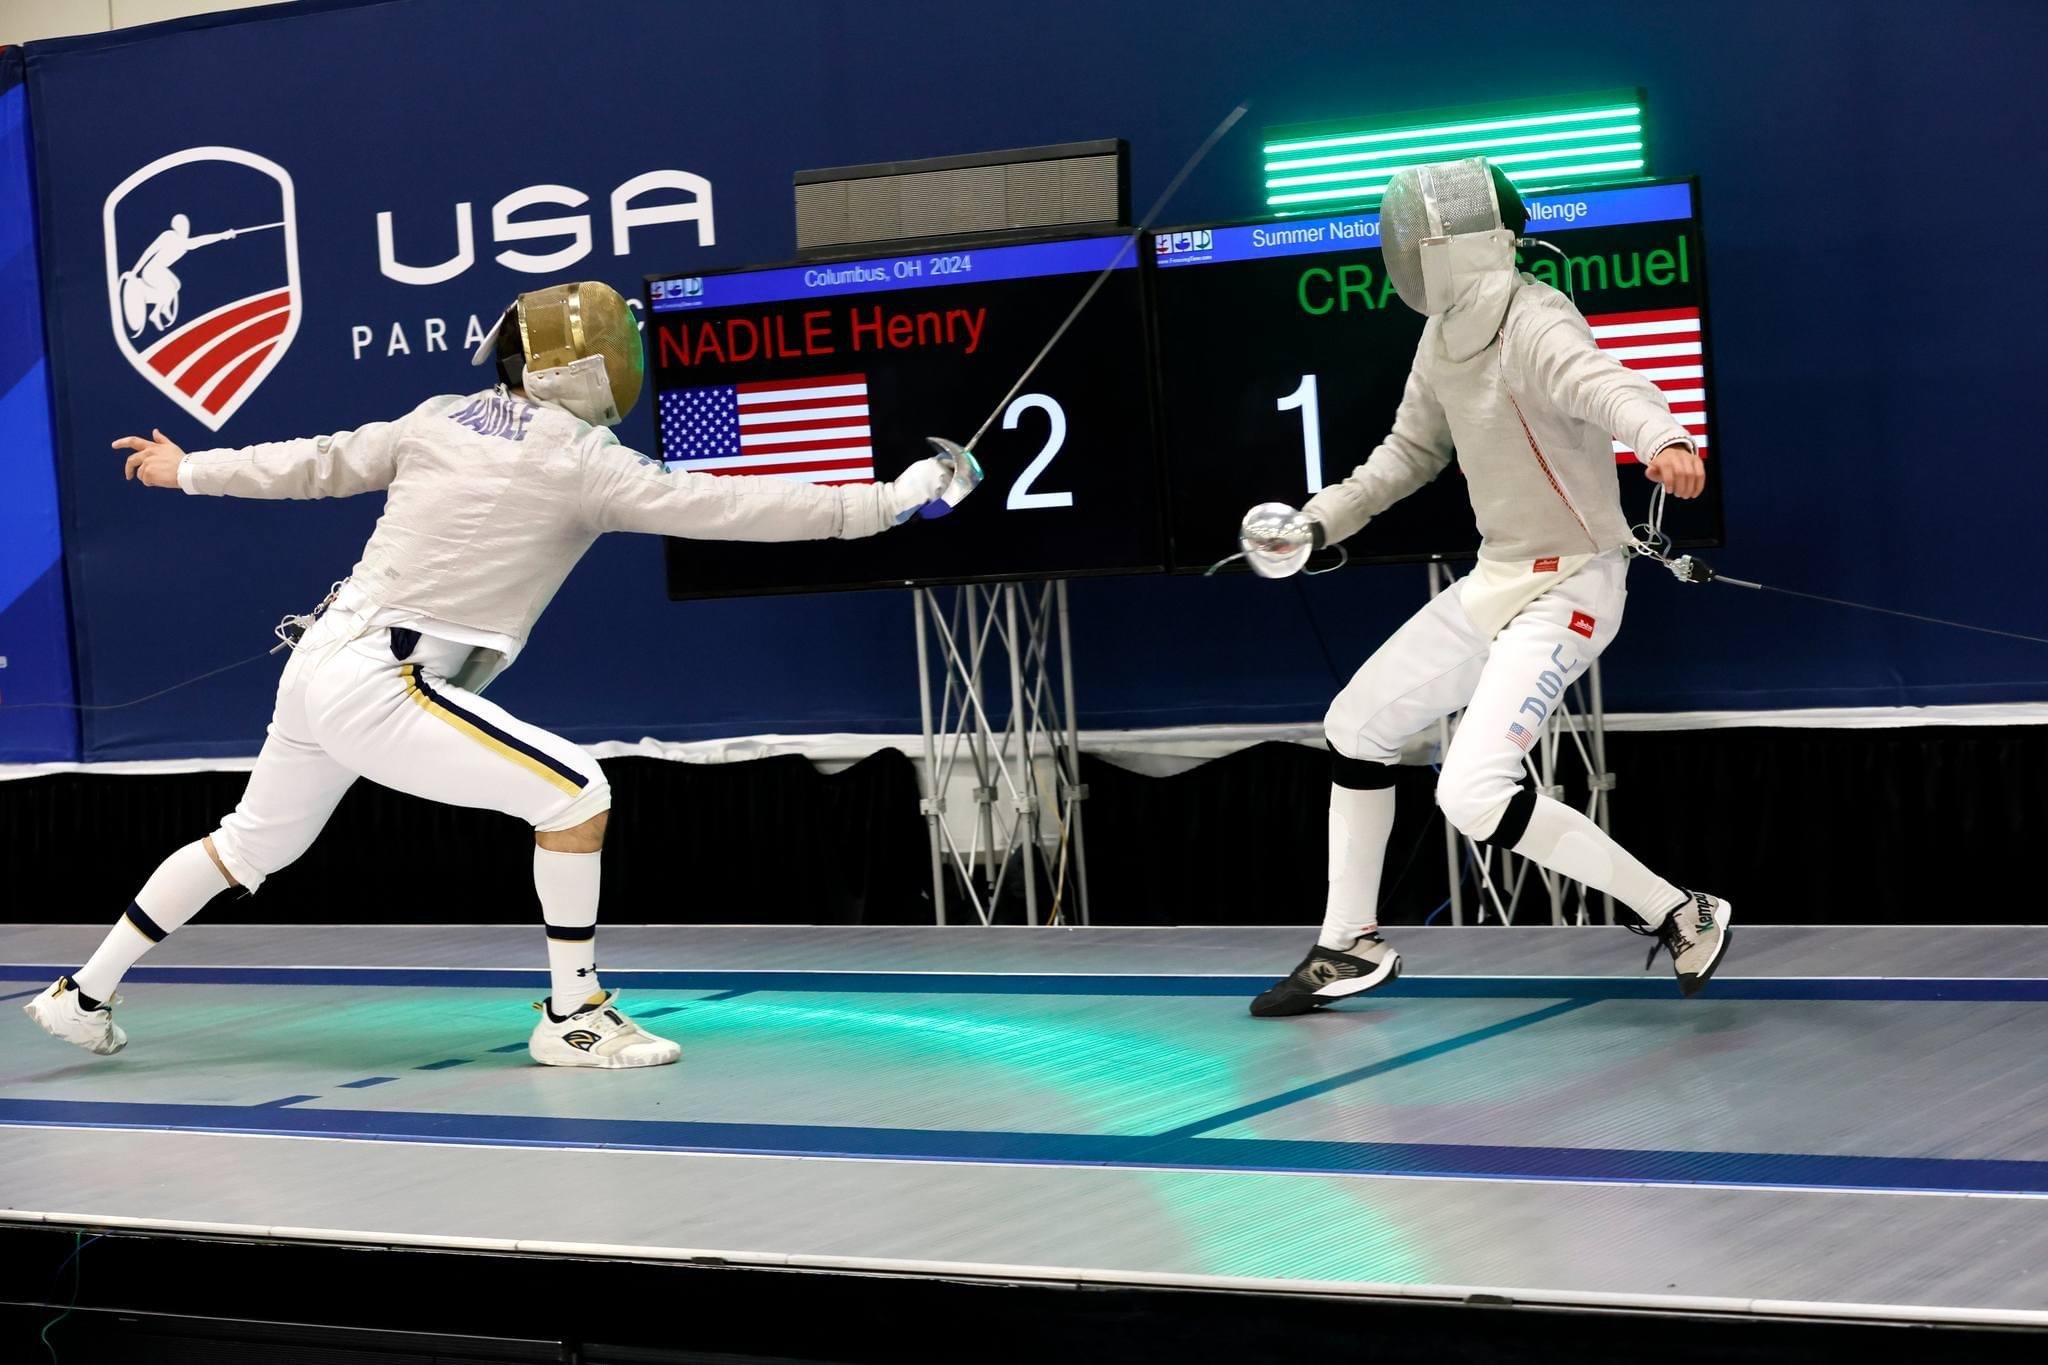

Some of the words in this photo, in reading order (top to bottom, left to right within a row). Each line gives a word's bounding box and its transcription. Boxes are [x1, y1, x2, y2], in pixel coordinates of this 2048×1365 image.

[376, 169, 716, 286] USA
[1252, 227, 1325, 248] Summer
[804, 264, 889, 288] Columbus,
[893, 261, 922, 279] OH
[929, 255, 973, 275] 2024
[1515, 235, 1689, 292] amuel
[352, 314, 487, 360] PARA
[659, 309, 834, 369] NADILE
[851, 304, 987, 354] Henry
[448, 397, 538, 441] NADILE
[1277, 374, 1323, 495] 1
[1002, 392, 1074, 510] 2
